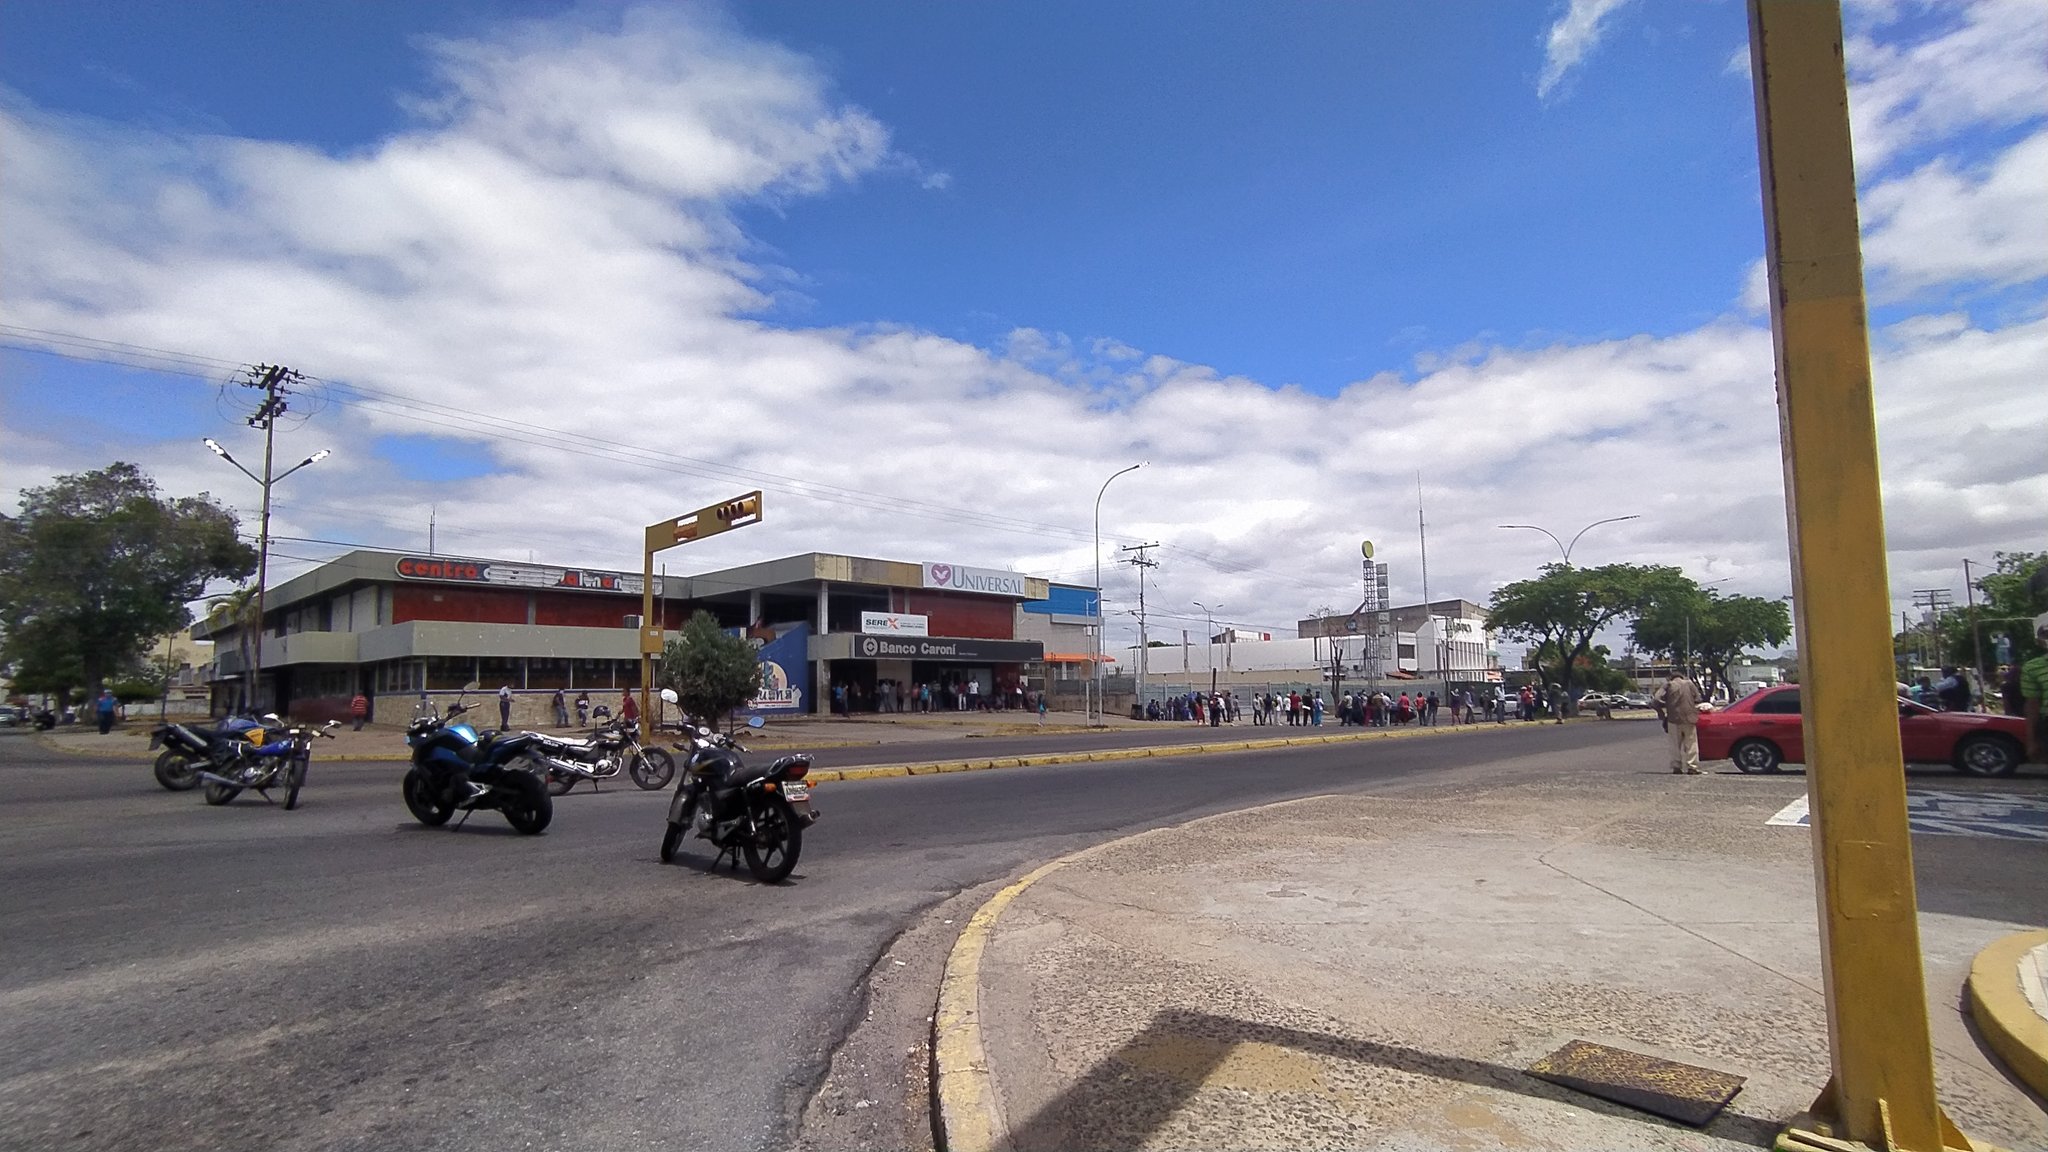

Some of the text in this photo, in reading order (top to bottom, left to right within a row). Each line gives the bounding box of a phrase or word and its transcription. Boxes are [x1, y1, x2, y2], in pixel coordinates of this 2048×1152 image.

[399, 560, 478, 580] centro
[952, 566, 1024, 594] UNIVERSAL
[865, 616, 899, 630] SEREX
[880, 641, 956, 655] Banco Caroní
